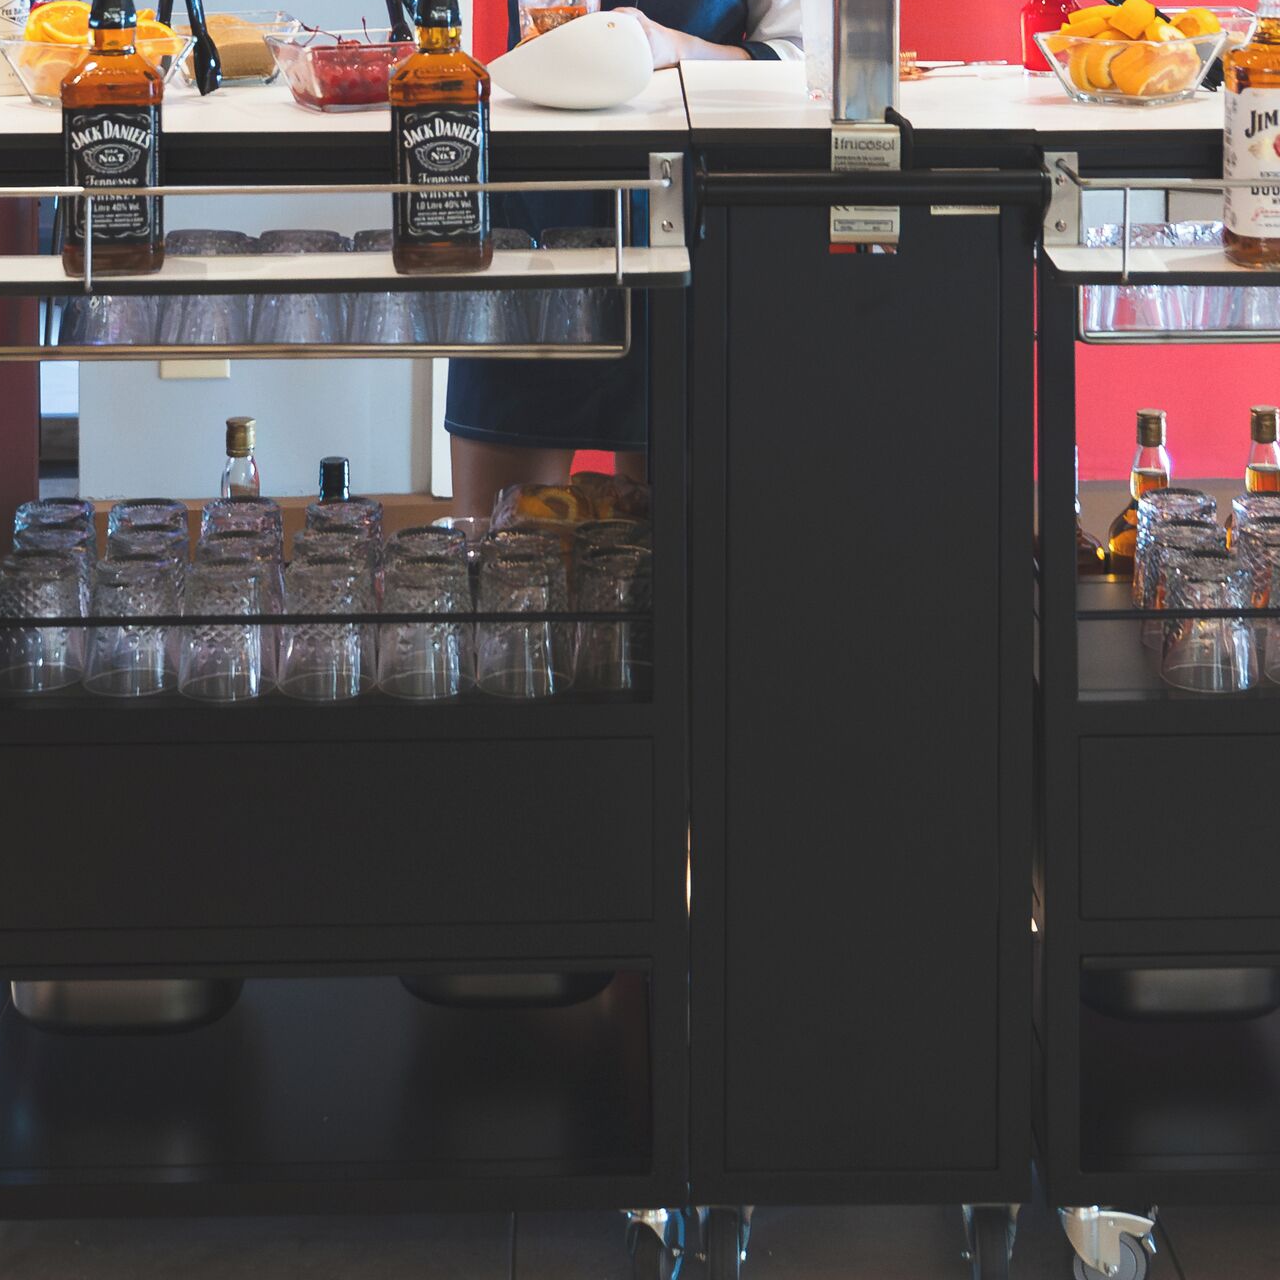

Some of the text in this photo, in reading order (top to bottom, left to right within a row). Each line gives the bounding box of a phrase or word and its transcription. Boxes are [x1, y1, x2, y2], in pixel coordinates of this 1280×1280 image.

[403, 123, 434, 148] JACK
[1245, 109, 1278, 138] JIM
[71, 125, 102, 150] JACK
[85, 175, 138, 186] Tennessee
[418, 172, 470, 184] Tennessee
